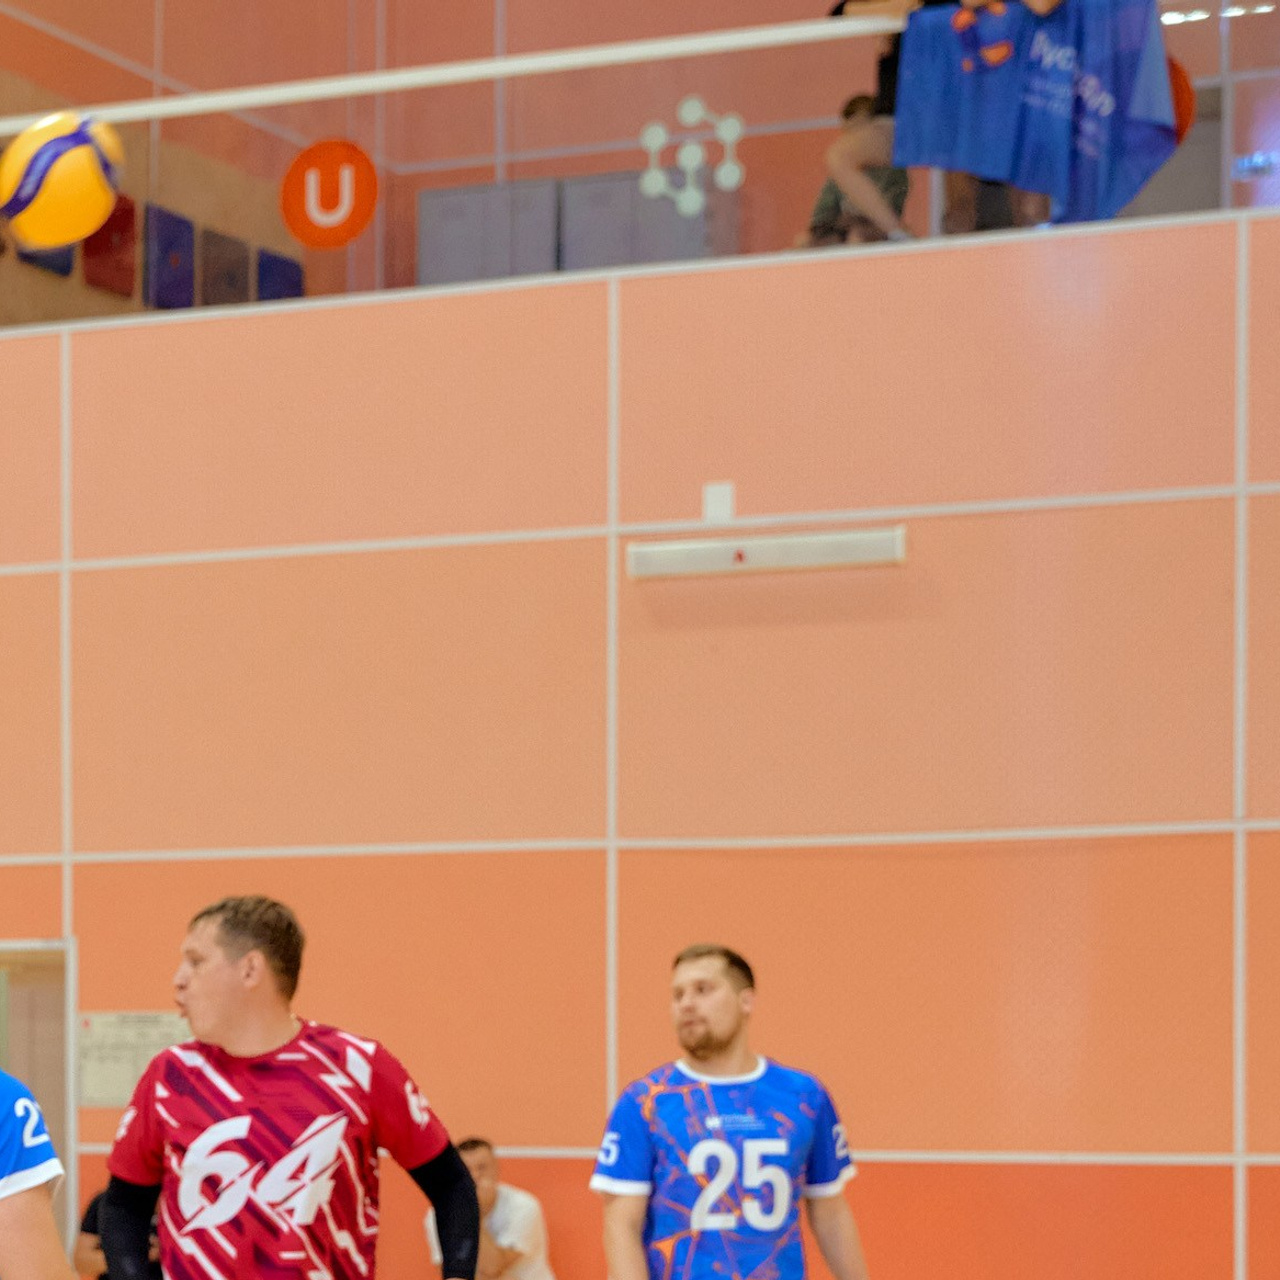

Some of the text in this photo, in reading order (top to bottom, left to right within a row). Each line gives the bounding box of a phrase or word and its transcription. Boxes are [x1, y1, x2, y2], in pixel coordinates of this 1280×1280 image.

[14, 1097, 50, 1148] 2
[178, 1111, 349, 1236] 64
[687, 1138, 793, 1231] 25
